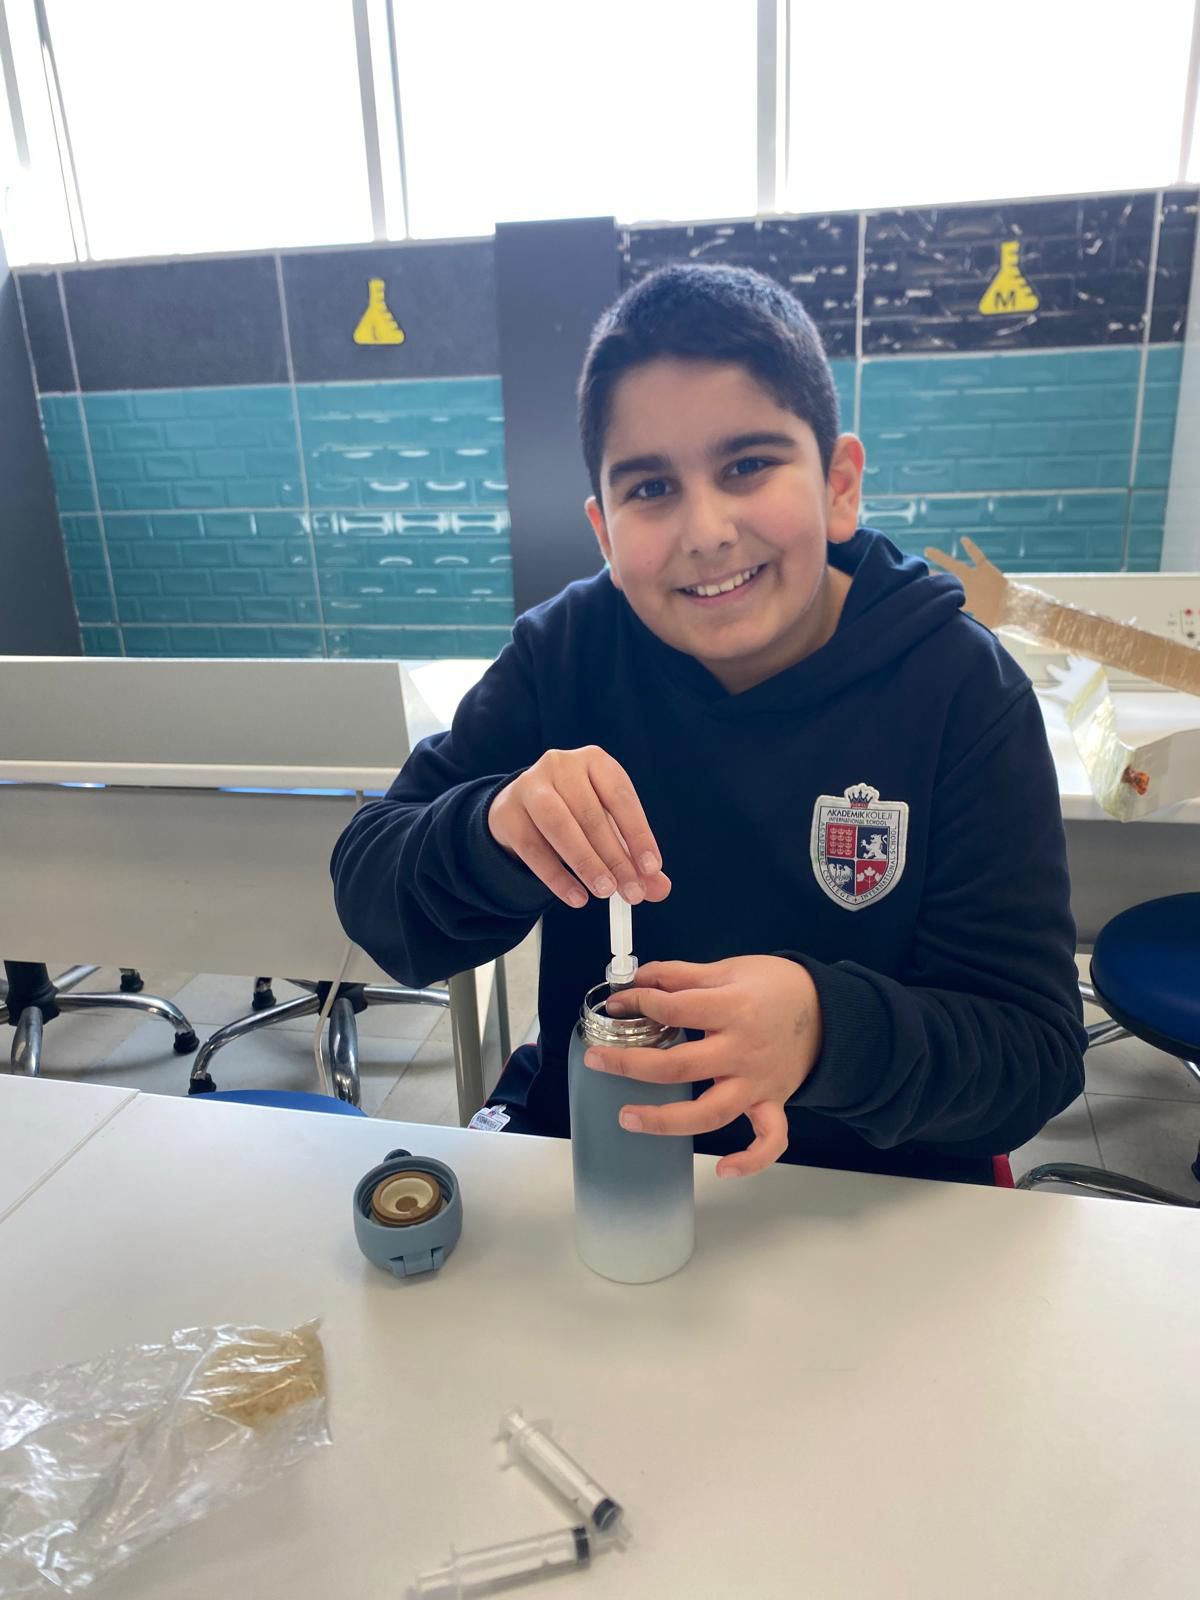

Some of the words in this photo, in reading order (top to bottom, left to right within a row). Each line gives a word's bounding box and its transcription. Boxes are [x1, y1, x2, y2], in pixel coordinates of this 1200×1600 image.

[995, 290, 1016, 310] M
[828, 817, 865, 825] INTERNATIONAL
[822, 869, 851, 902] COLLEGE
[860, 857, 897, 901] INTERNATIONAL
